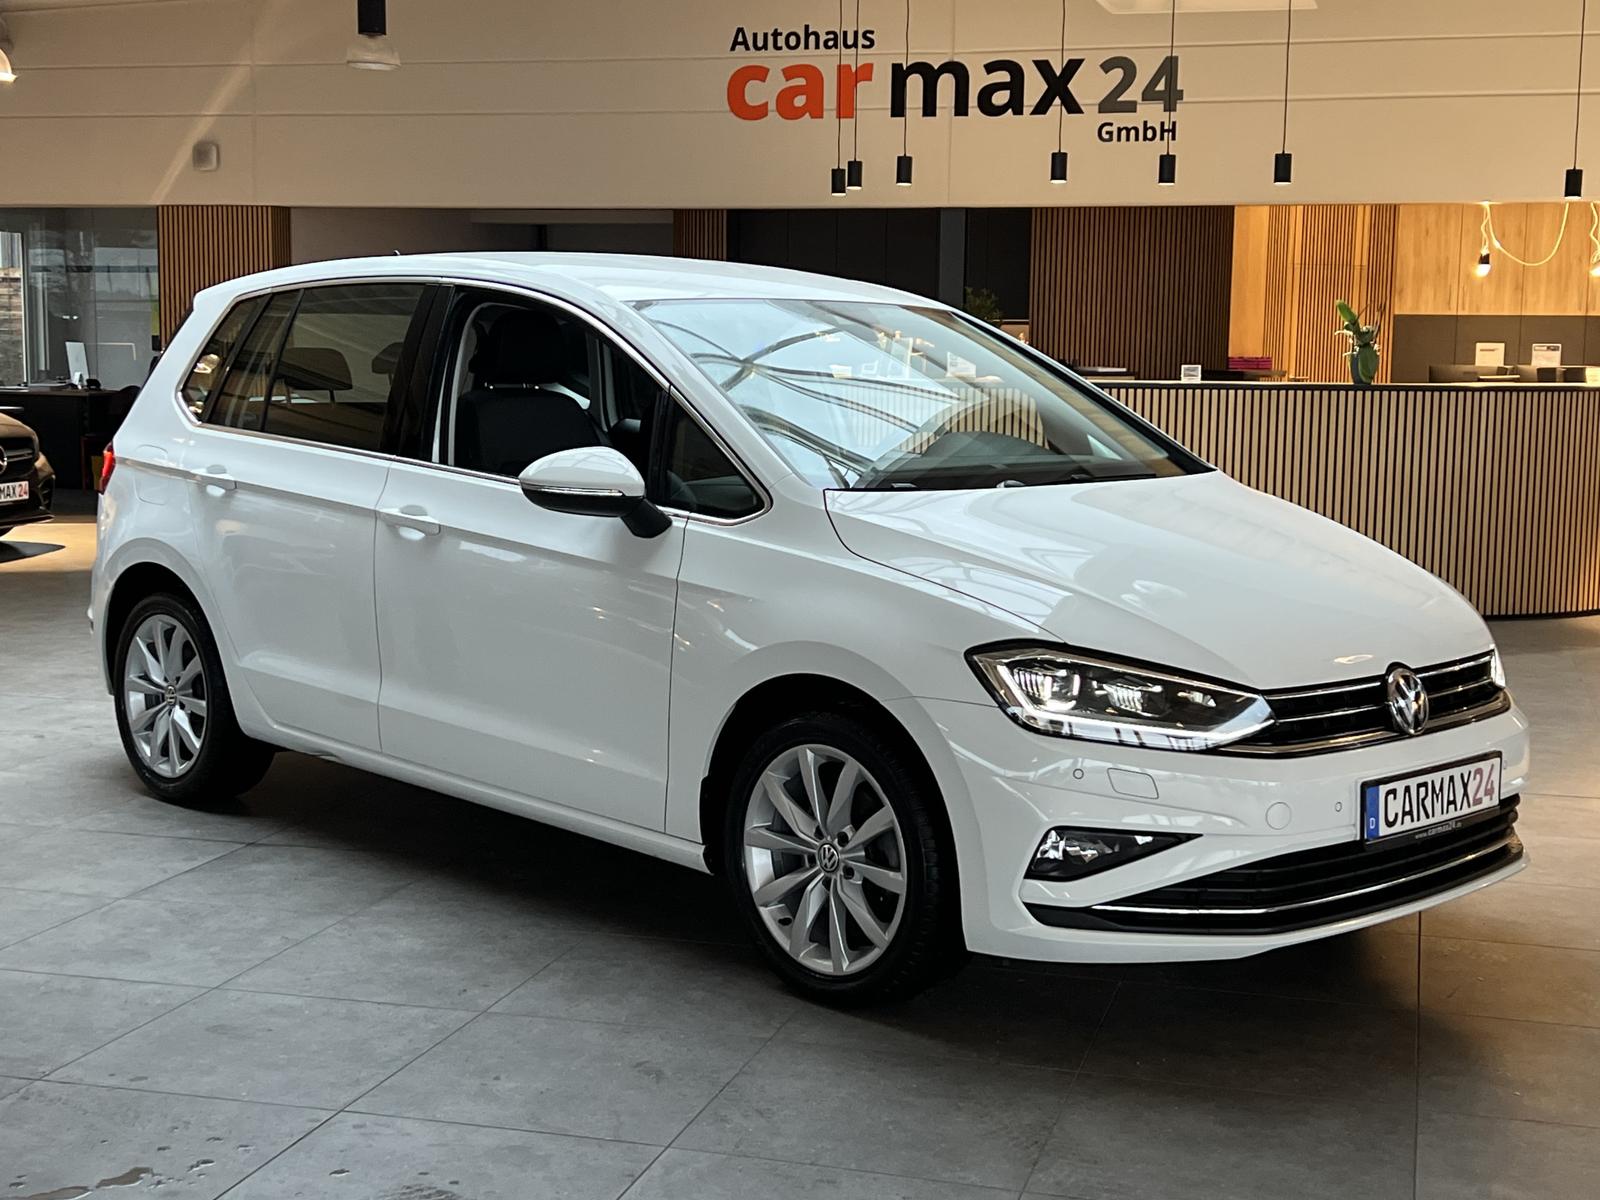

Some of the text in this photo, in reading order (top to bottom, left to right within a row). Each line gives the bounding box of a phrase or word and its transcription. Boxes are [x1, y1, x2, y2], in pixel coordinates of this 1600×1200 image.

[730, 25, 876, 52] Autohaus
[1097, 121, 1177, 143] GmbH
[1384, 763, 1496, 829] CARMAX24
[1369, 817, 1376, 829] D
